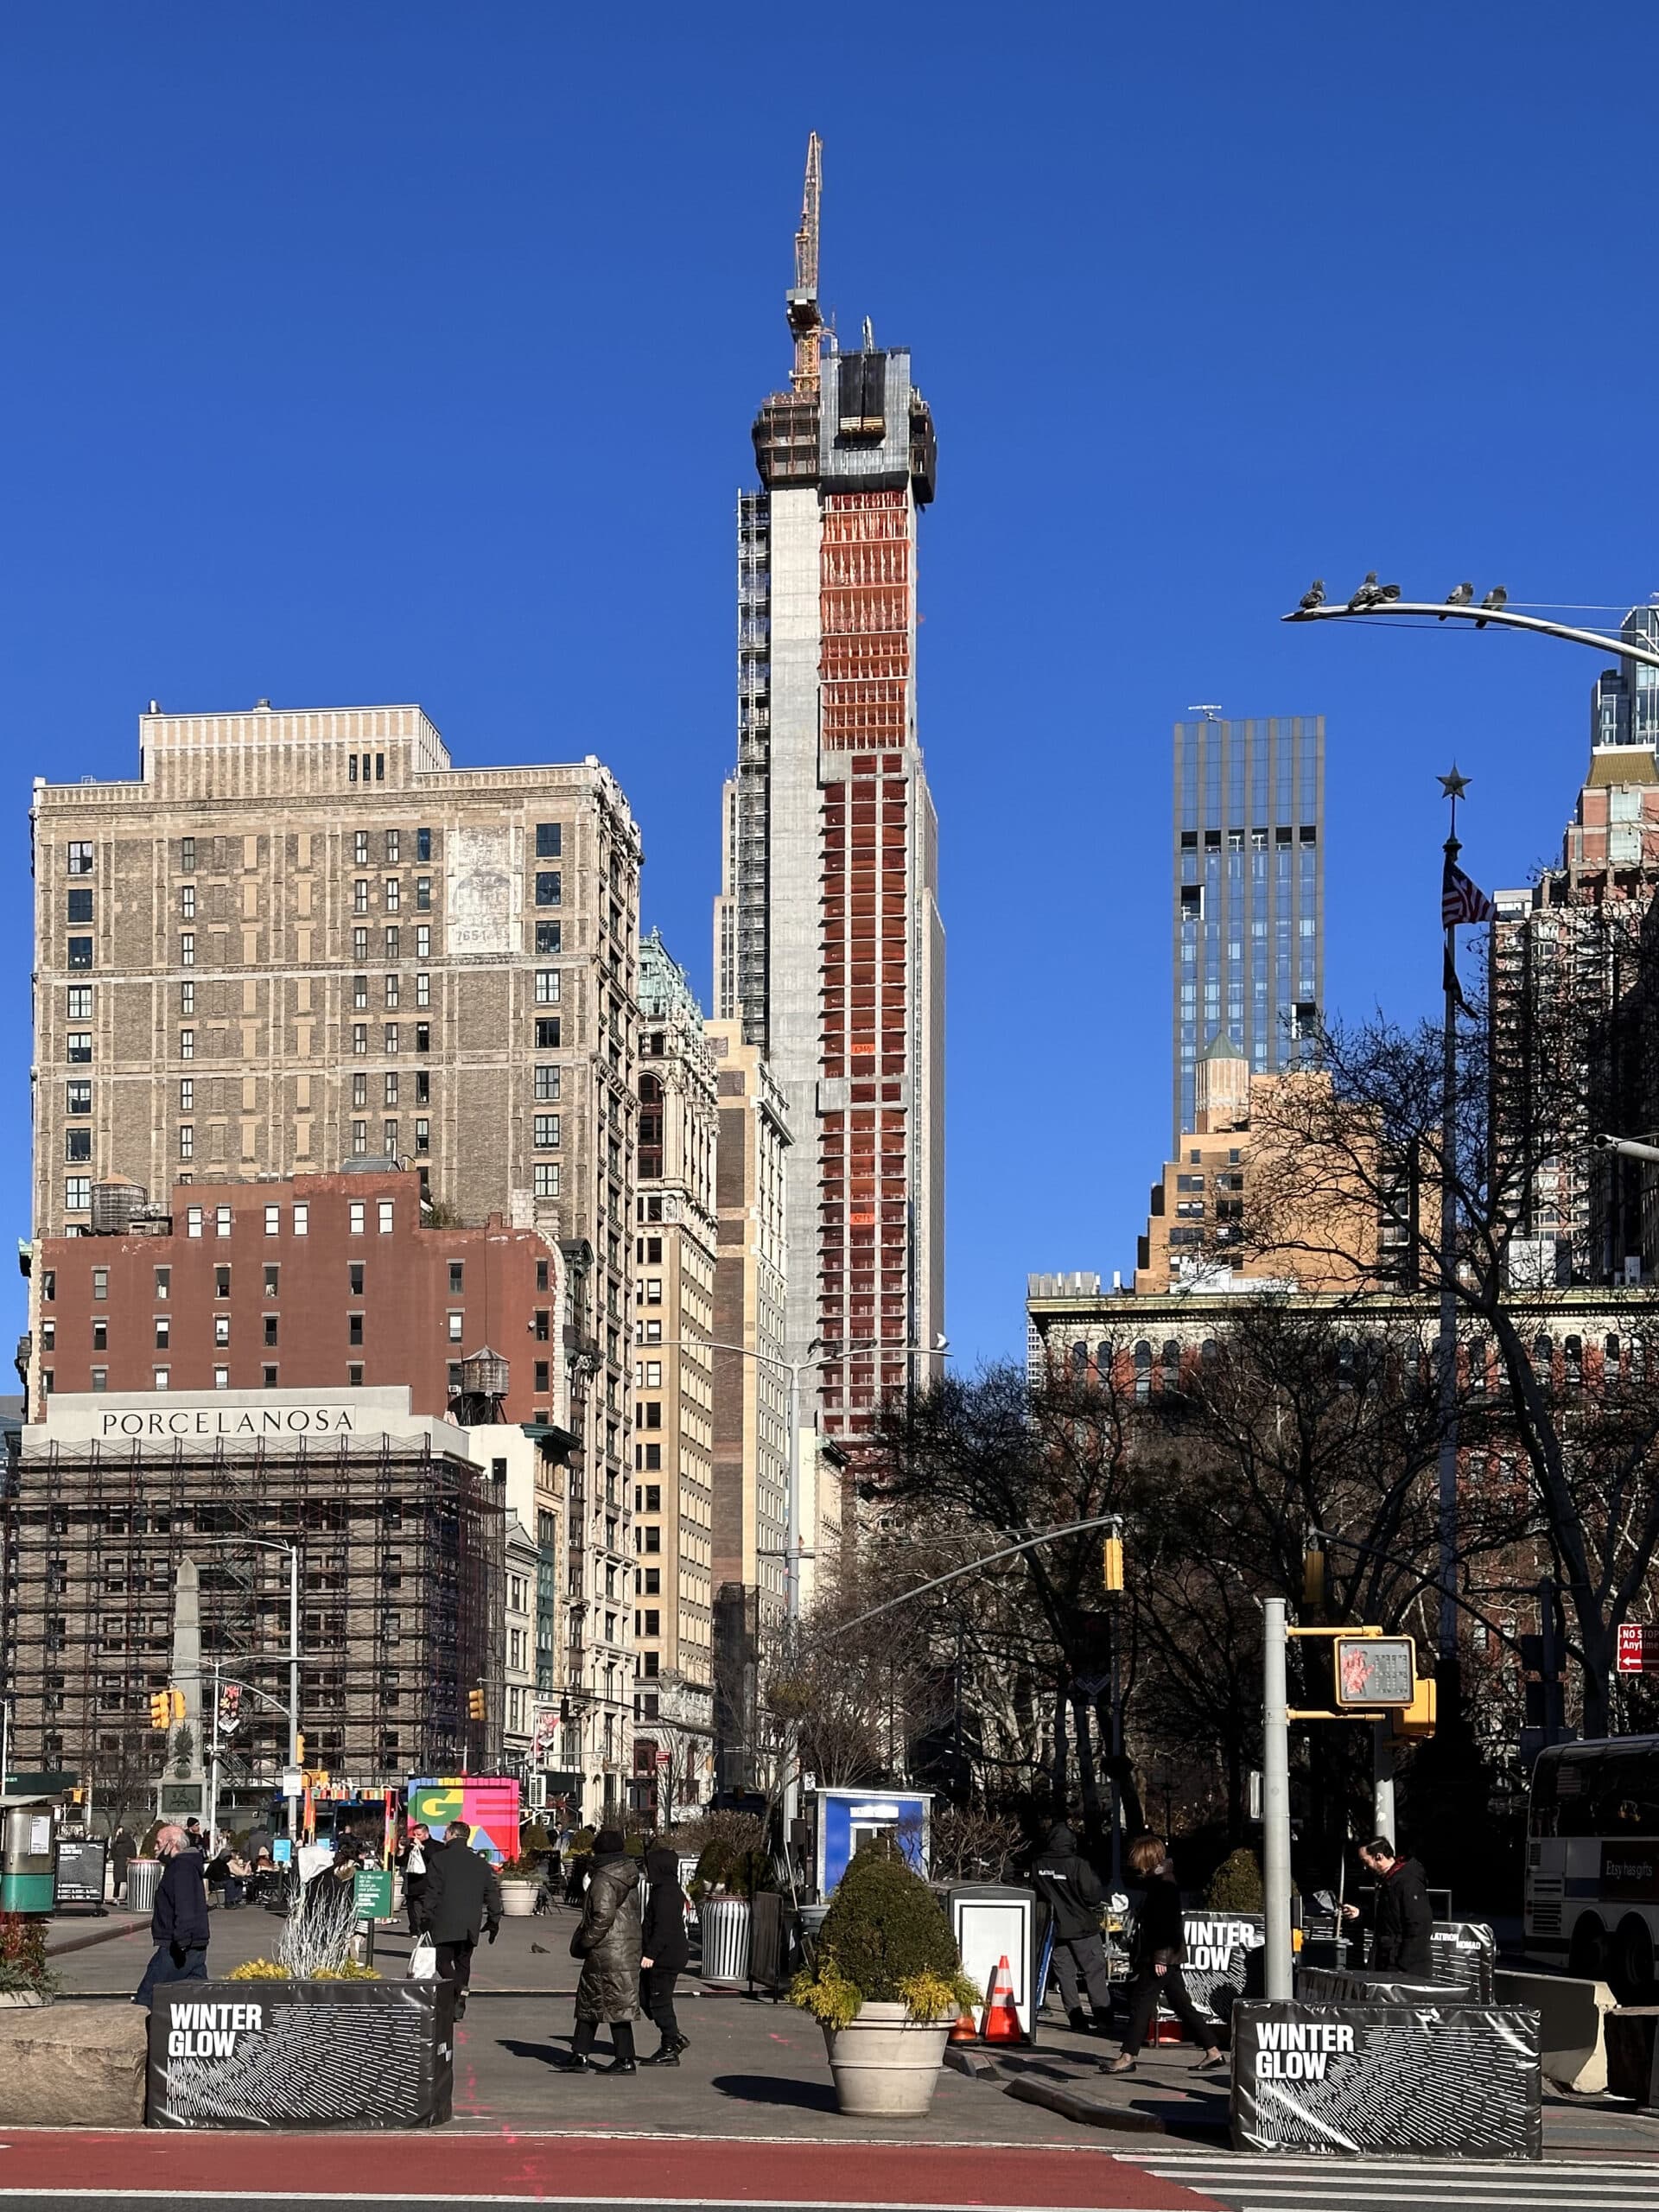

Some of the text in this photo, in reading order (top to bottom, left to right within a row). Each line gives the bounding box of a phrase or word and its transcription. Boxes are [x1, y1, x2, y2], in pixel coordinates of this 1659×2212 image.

[104, 1410, 353, 1434] PORCELANOSA
[1623, 1630, 1636, 1639] NO
[1623, 1639, 1659, 1651] Anytime
[1605, 1860, 1622, 1879] Etsy
[1624, 1859, 1636, 1876] has
[1430, 1932, 1460, 1942] LATIRON
[1180, 1946, 1231, 1971] LOW
[169, 2003, 263, 2031] WINTER
[168, 2030, 236, 2057] GLOW
[1255, 2022, 1355, 2052] WINTER
[1255, 2050, 1327, 2080] GLOW
